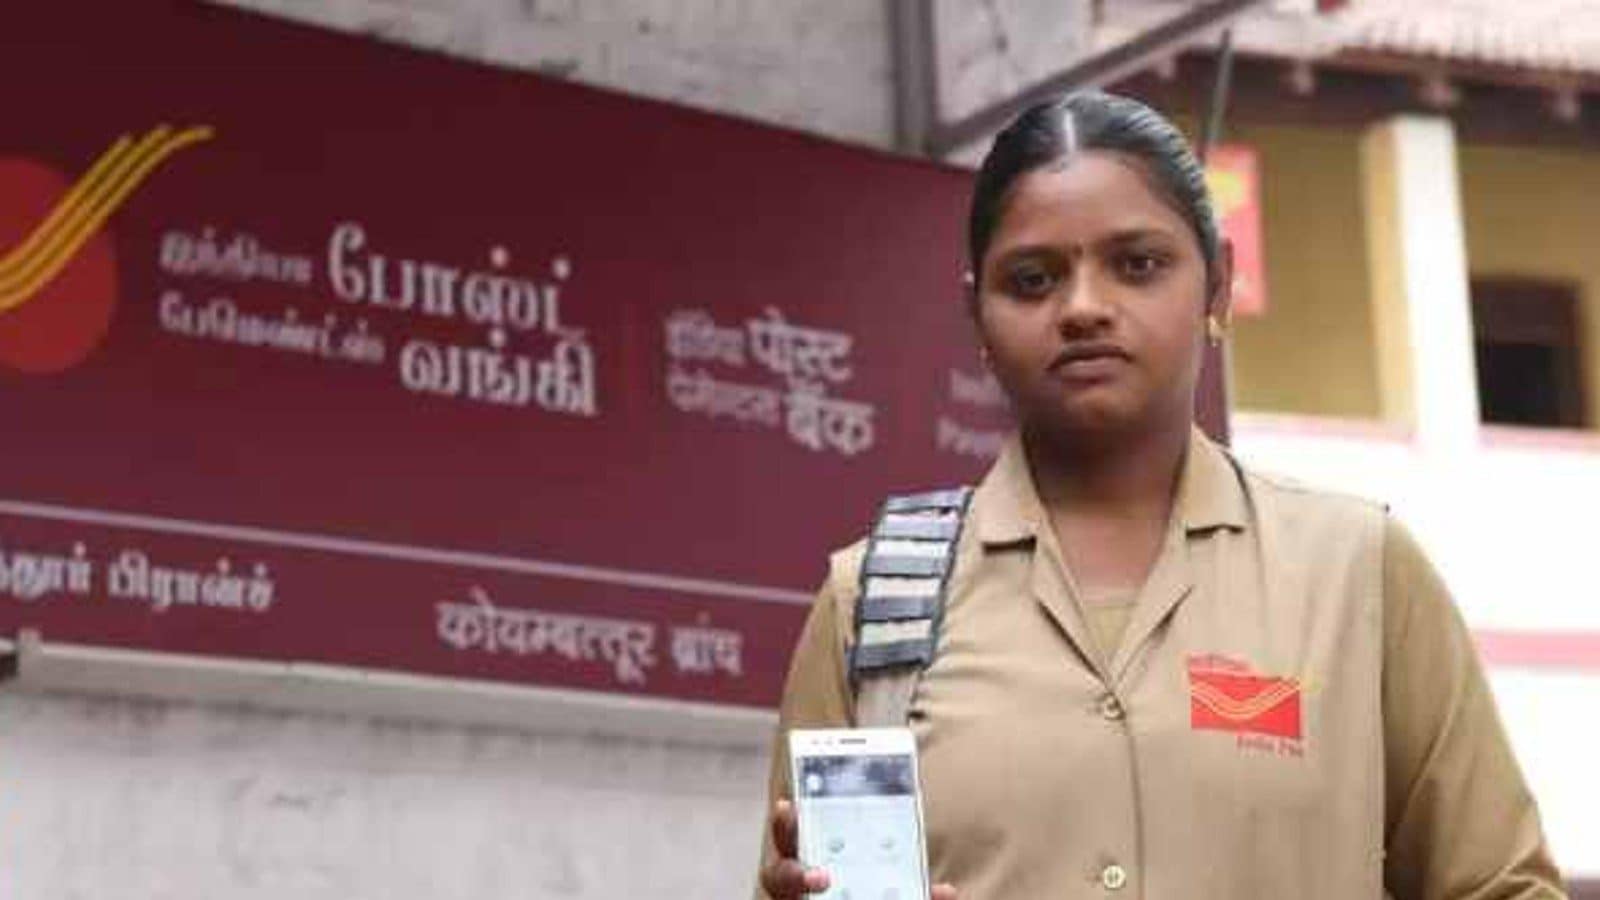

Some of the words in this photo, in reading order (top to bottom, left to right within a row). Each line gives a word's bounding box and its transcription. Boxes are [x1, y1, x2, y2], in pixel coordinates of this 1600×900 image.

[328, 222, 580, 336] போஸ்ட்
[400, 328, 597, 416] வங்கி
[748, 305, 854, 382] पोस्ट
